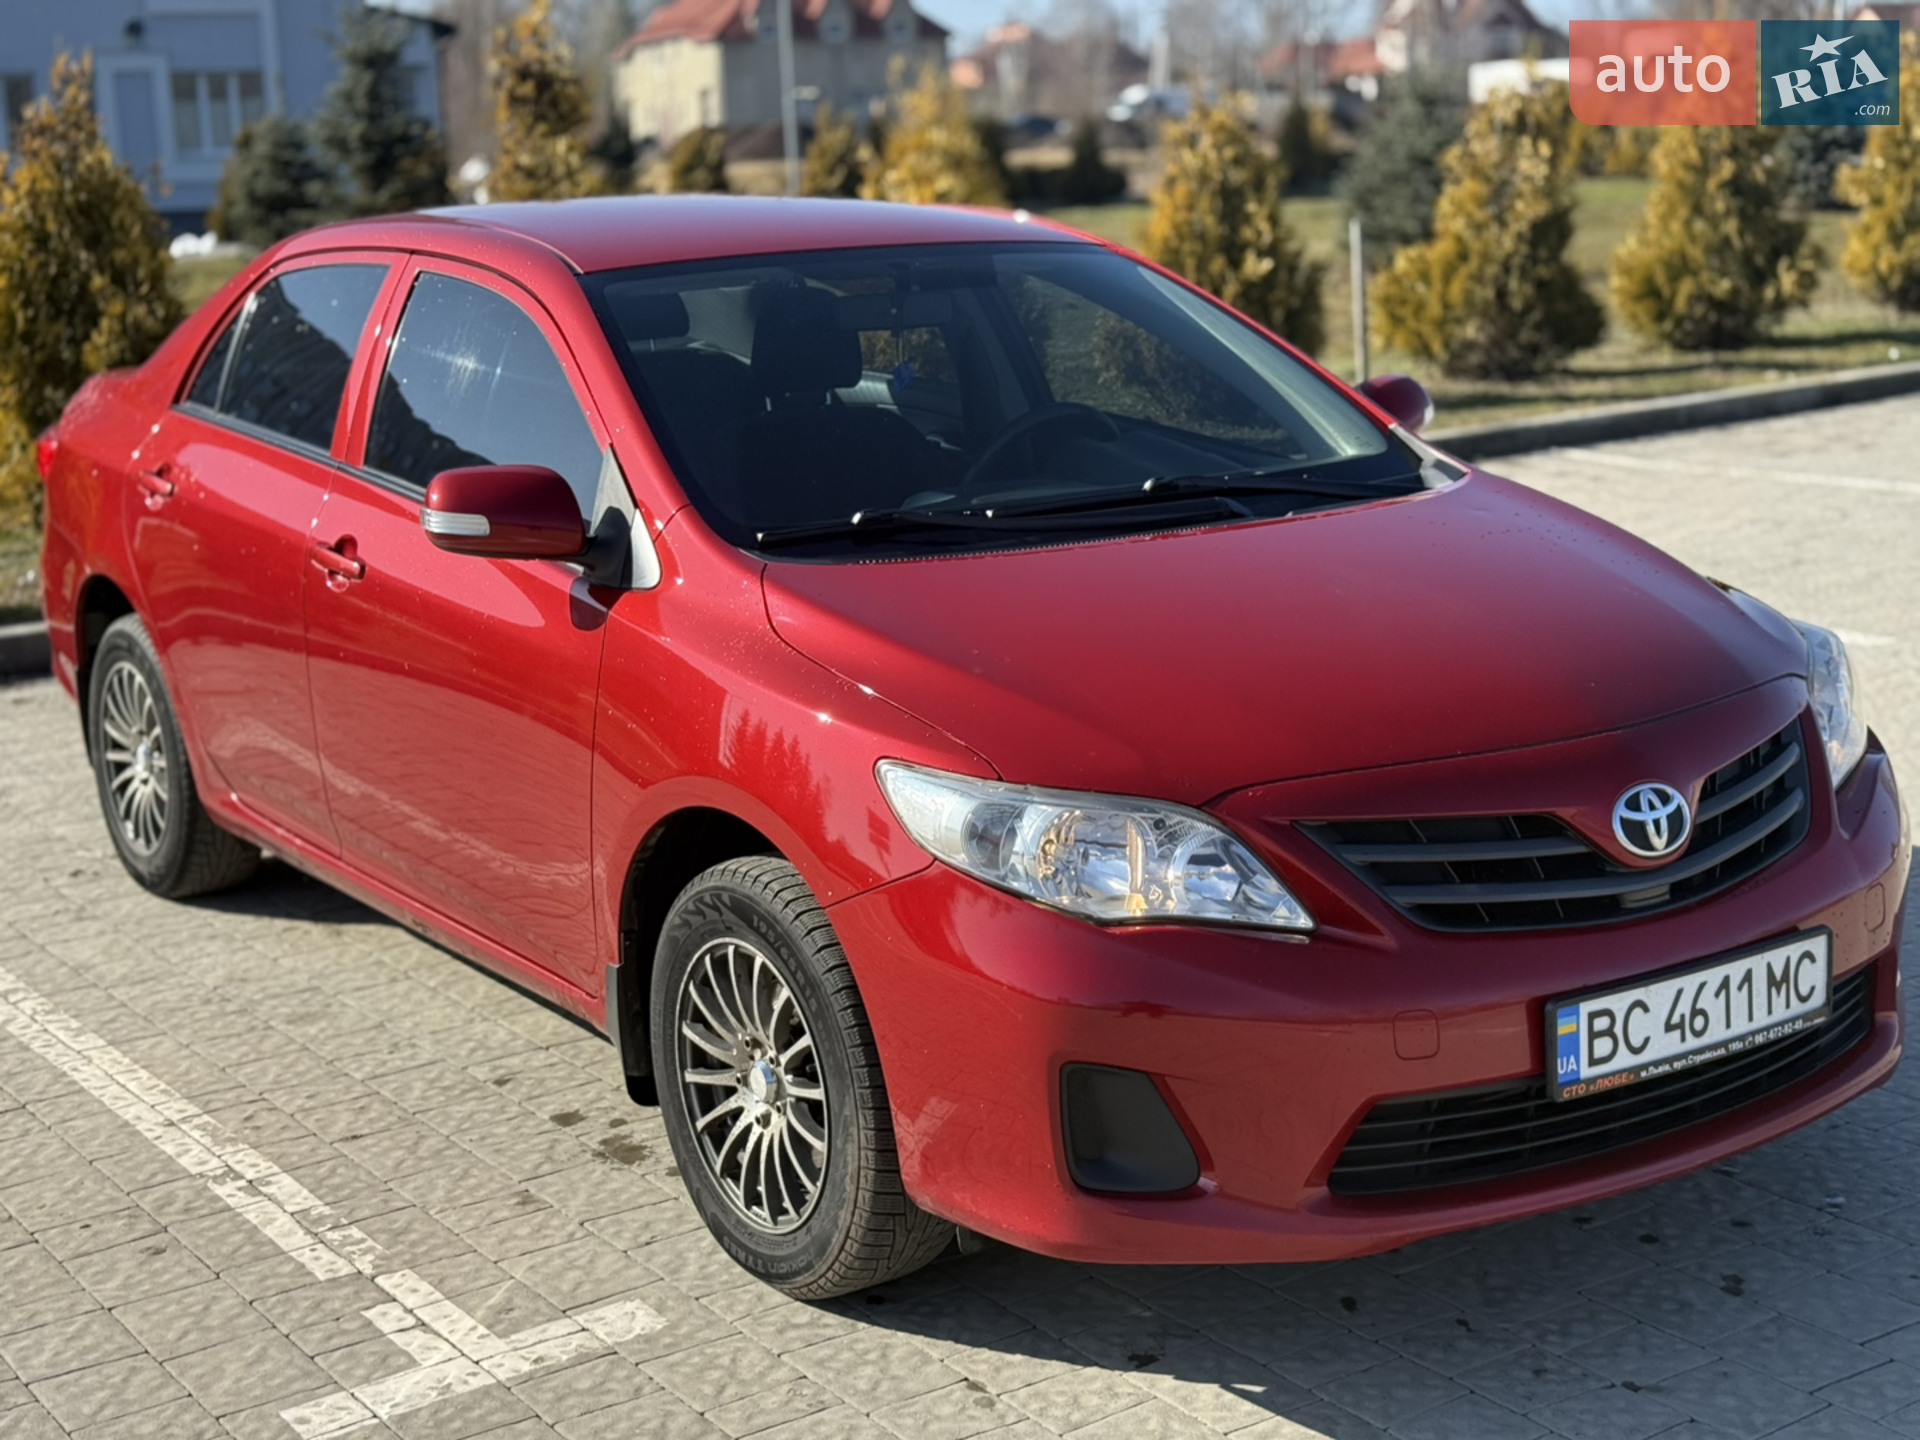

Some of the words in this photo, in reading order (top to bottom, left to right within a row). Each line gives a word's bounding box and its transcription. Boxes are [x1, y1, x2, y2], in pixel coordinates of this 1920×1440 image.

[1587, 999, 1651, 1068] BC
[1663, 967, 1754, 1044] 4611
[1766, 950, 1817, 1017] MC
[1557, 1055, 1578, 1075] UA
